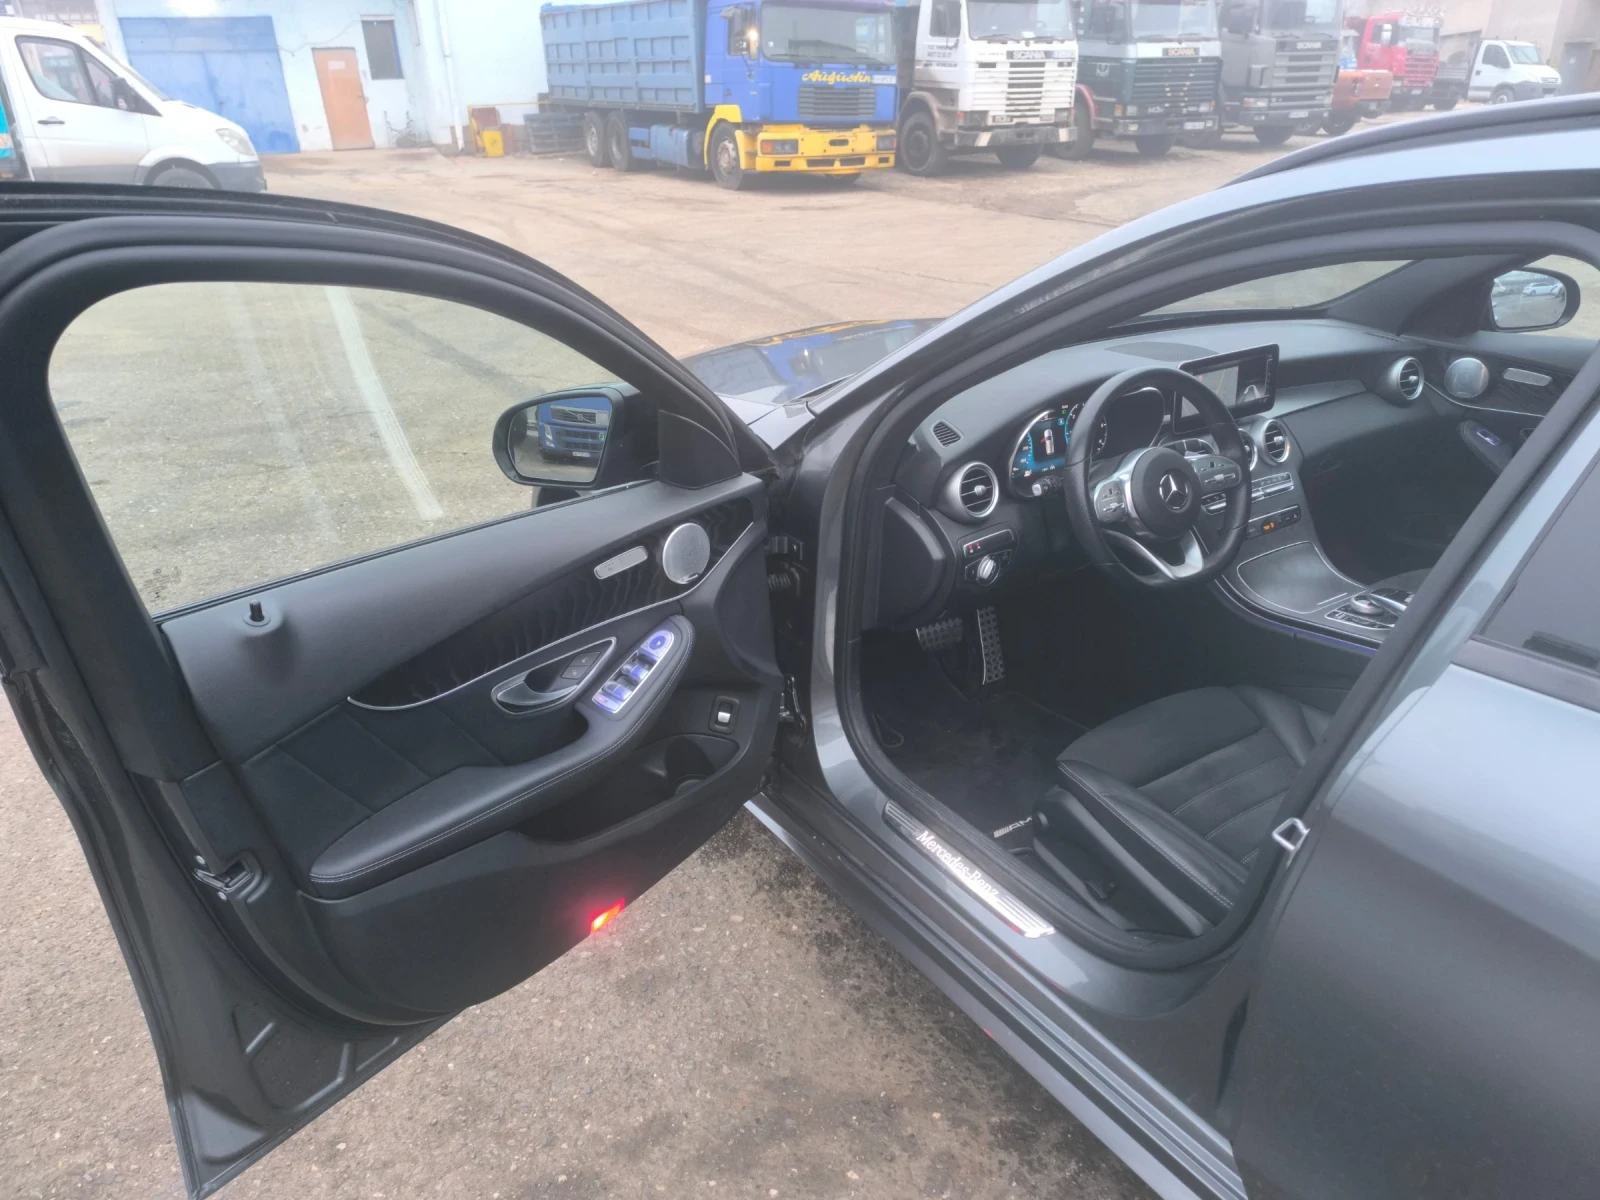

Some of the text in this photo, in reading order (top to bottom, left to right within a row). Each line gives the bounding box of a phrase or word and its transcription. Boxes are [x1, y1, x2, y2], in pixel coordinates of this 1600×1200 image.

[1296, 41, 1322, 50] SCANIA
[1012, 50, 1046, 60] SCANIA
[1167, 47, 1196, 57] SCANIA
[915, 830, 1000, 899] Mercedes-Benz
